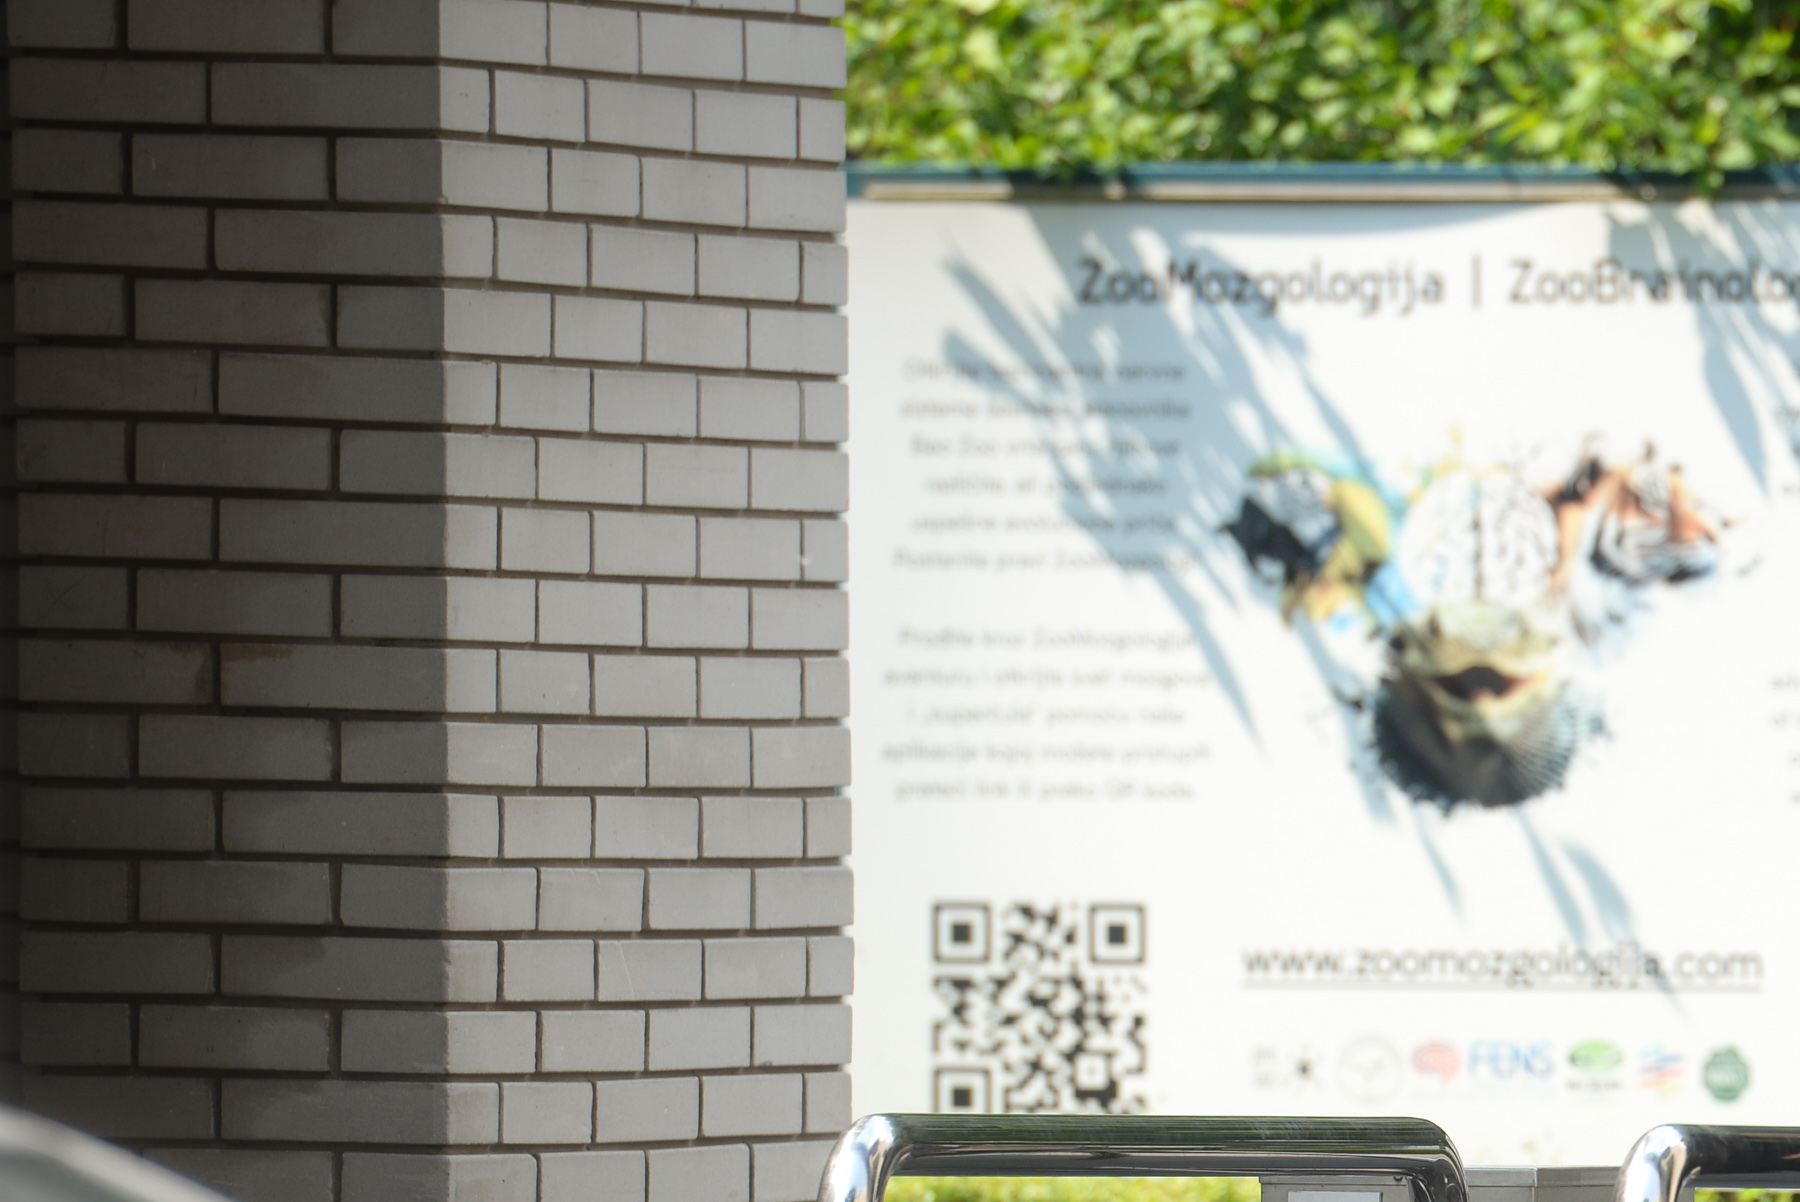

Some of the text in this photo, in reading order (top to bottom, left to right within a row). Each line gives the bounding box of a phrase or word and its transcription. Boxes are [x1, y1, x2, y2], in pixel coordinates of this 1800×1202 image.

[1079, 257, 1445, 317] ZooMozgologija
[1241, 944, 1764, 988] www.zoomozgologija.com
[1468, 1040, 1556, 1079] FENS
